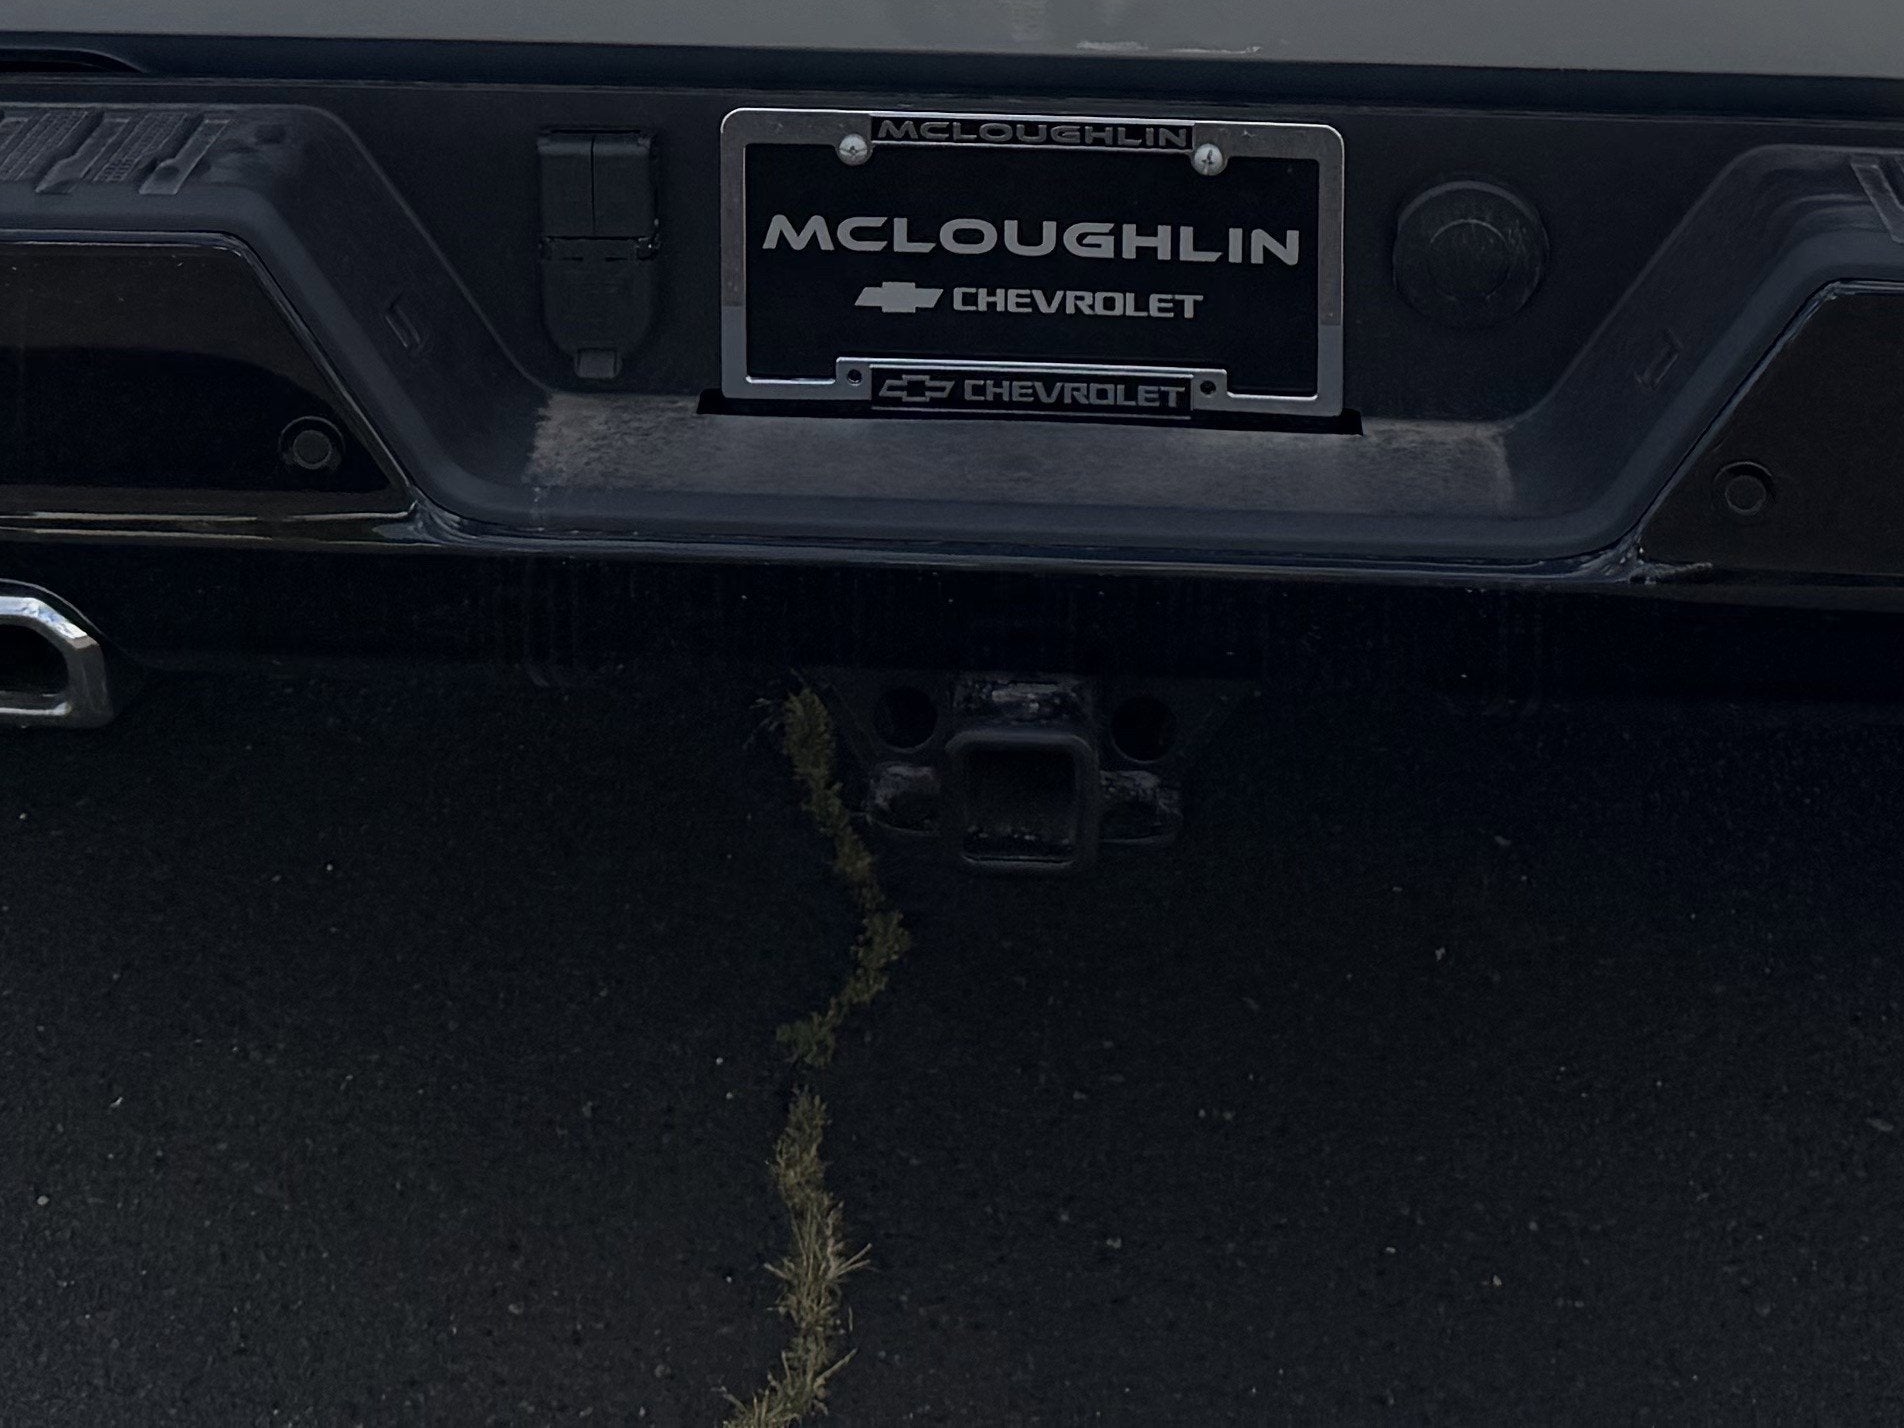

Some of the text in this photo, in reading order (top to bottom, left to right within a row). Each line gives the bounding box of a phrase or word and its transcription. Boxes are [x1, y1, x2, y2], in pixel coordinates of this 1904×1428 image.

[876, 119, 1192, 149] MCLOUGHLIN
[761, 214, 1301, 266] MCLOUGHLIN
[953, 287, 1204, 319] CHEVROLET
[963, 379, 1186, 409] CHEVROLET
